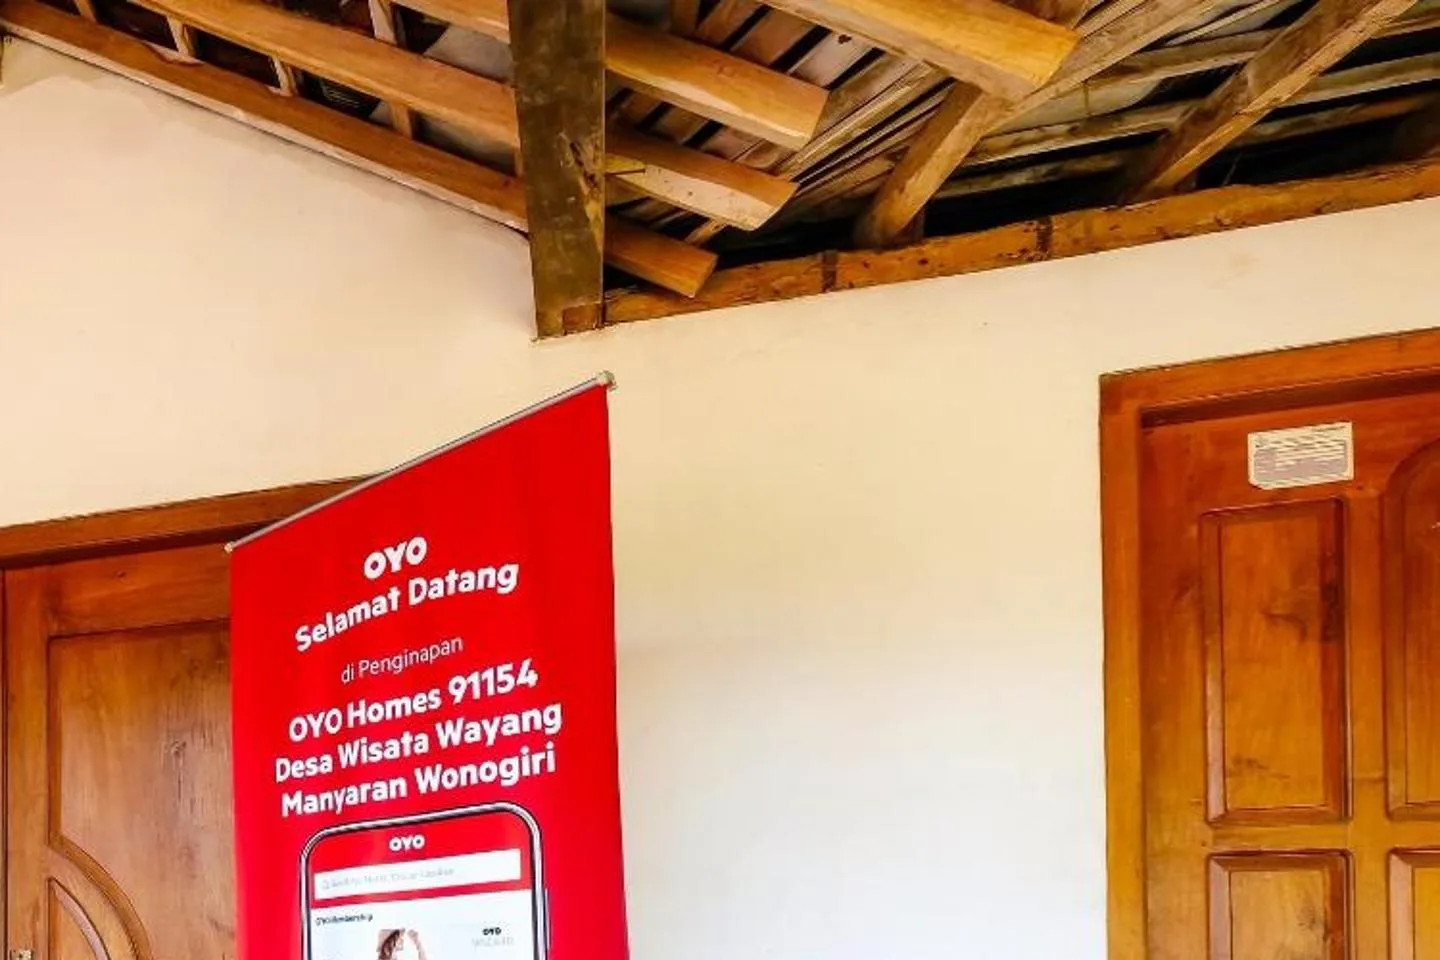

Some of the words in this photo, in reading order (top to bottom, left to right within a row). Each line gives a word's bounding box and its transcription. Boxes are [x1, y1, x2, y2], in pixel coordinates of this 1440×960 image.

[364, 537, 427, 581] OYO
[295, 586, 401, 651] Selamat
[409, 563, 520, 606] Datang
[341, 664, 355, 684] di
[358, 636, 463, 676] Penginapan
[289, 708, 342, 742] OYO
[347, 687, 441, 728] Homes
[448, 658, 538, 703] 91154
[275, 752, 333, 783] Desa
[338, 731, 429, 768] Wisata
[435, 703, 563, 750] Wayang
[282, 774, 408, 817] Manyaran
[414, 740, 557, 794] Wonogiri
[389, 835, 425, 851] OYO
